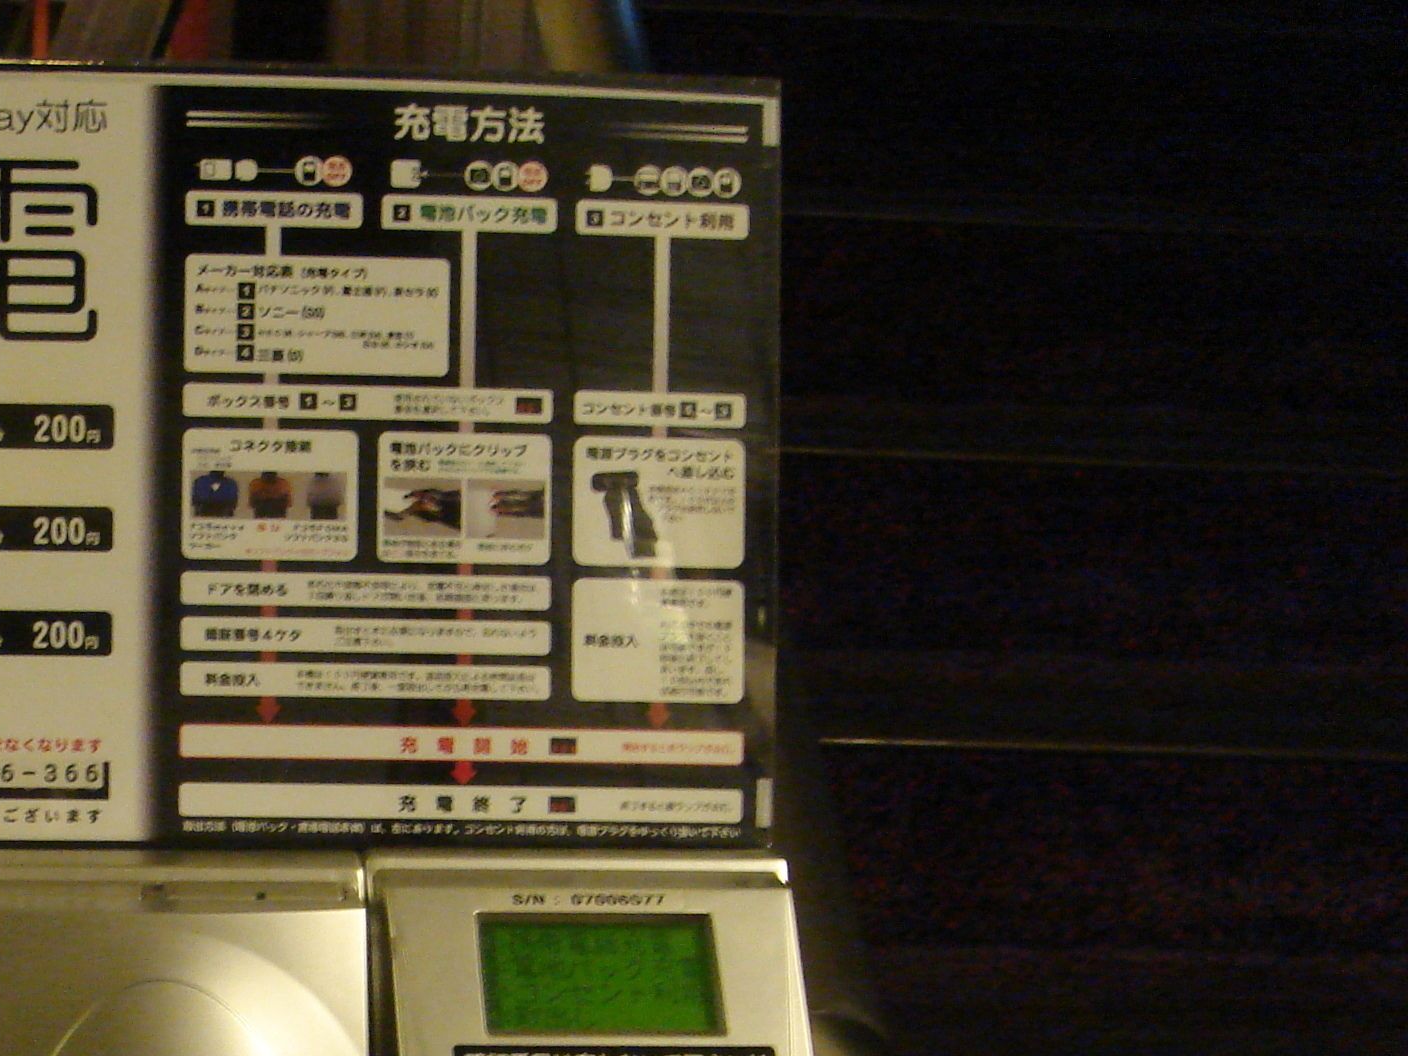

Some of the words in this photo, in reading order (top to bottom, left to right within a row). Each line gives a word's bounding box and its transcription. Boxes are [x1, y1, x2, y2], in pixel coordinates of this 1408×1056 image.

[394, 104, 546, 143] 充電方法
[33, 413, 101, 444] 200円
[32, 515, 101, 547] 200円
[32, 619, 99, 651] 200円
